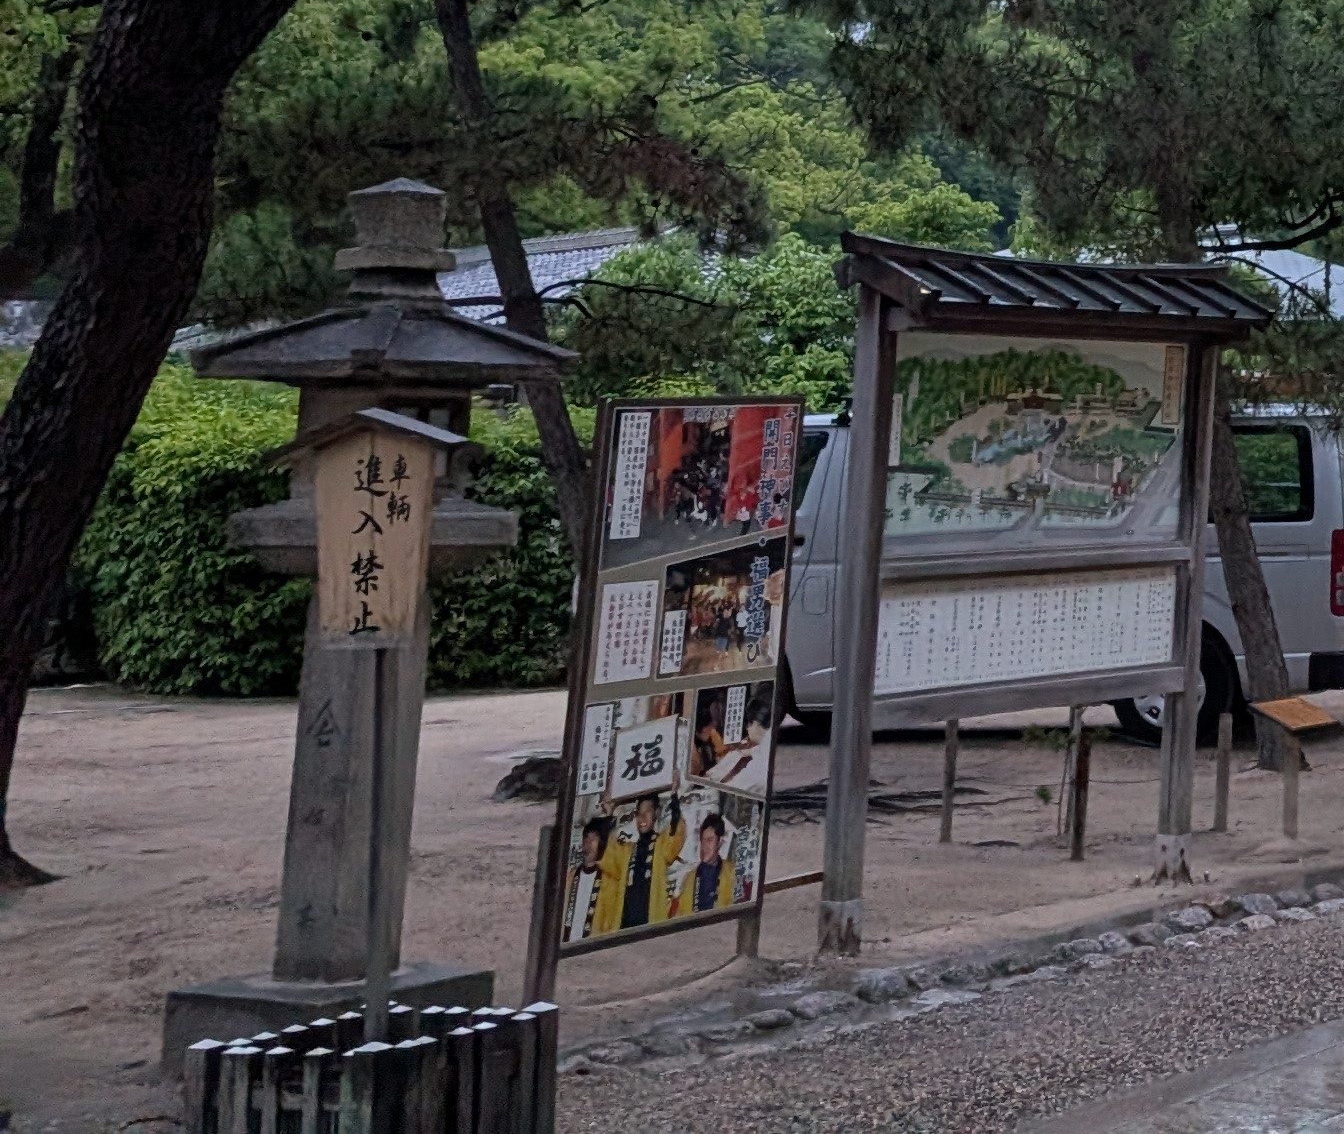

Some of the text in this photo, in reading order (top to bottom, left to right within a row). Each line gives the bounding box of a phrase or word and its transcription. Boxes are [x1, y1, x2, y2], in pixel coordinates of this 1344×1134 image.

[349, 454, 389, 635] 進入禁止
[621, 733, 665, 782] 福
